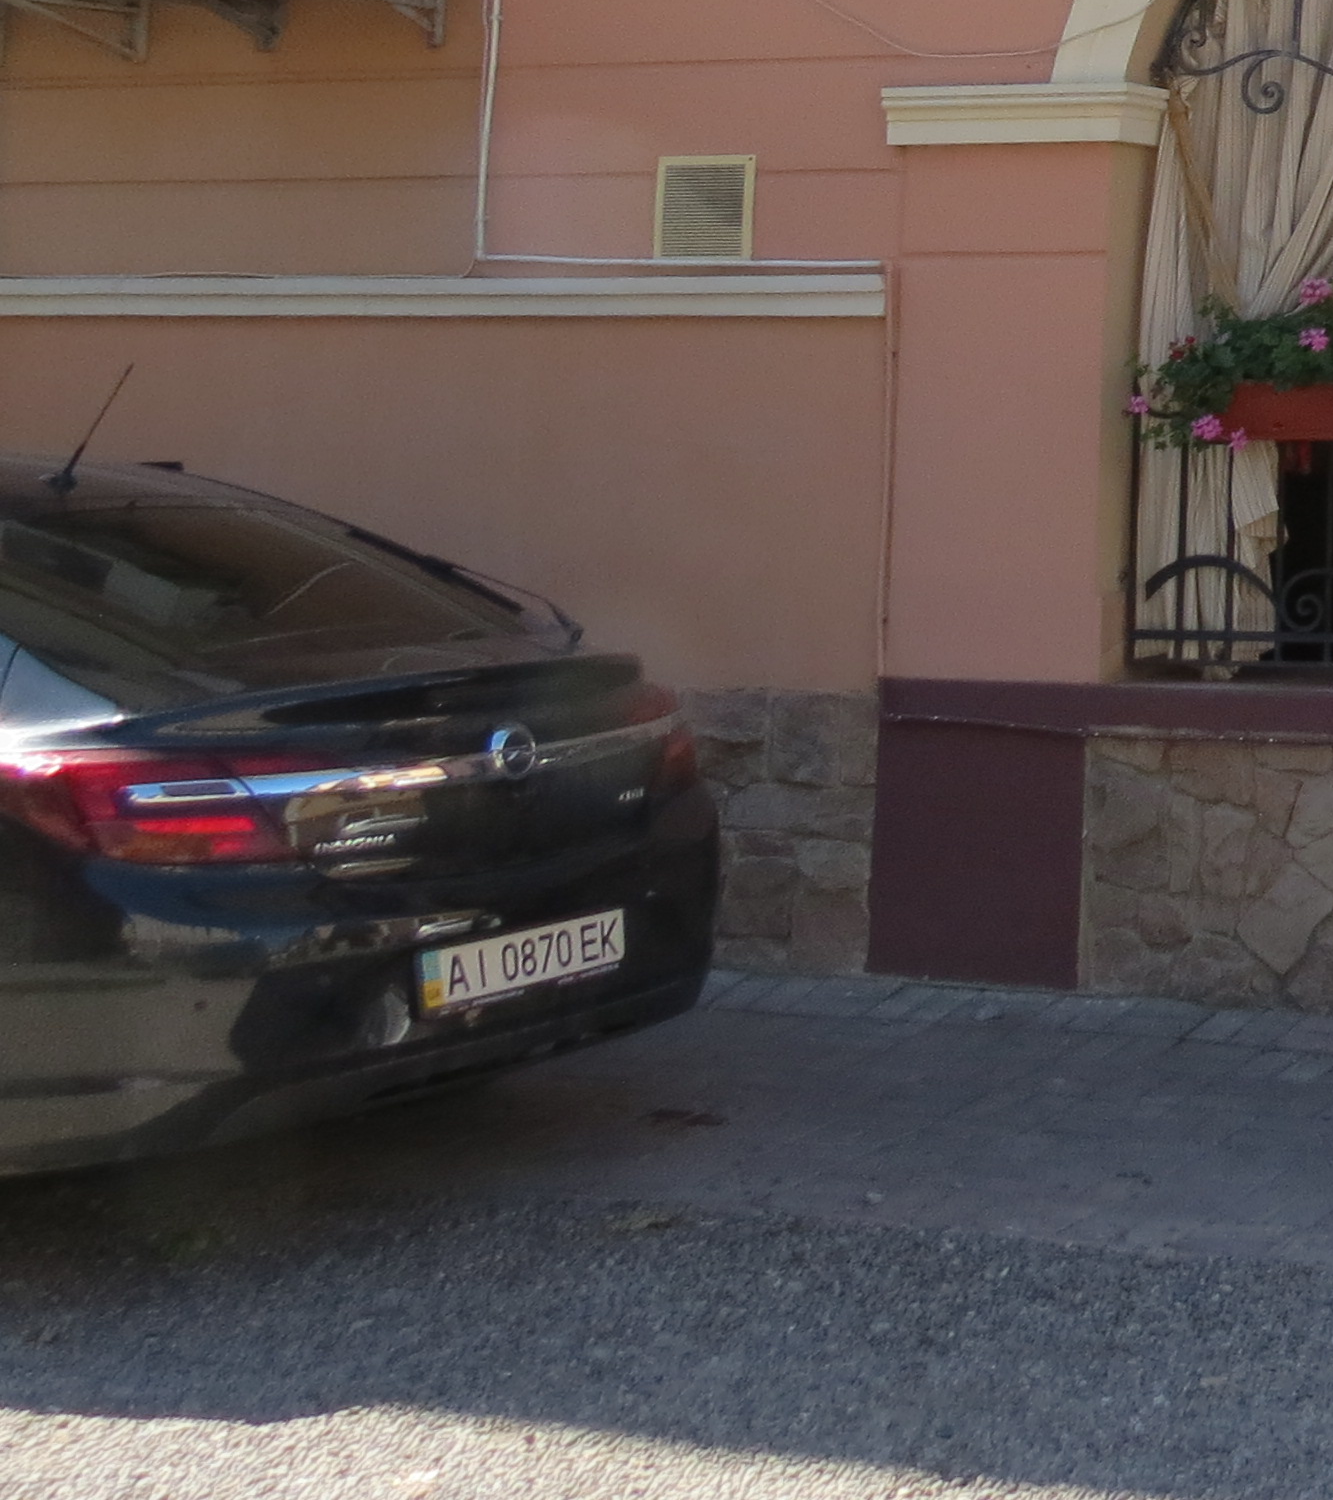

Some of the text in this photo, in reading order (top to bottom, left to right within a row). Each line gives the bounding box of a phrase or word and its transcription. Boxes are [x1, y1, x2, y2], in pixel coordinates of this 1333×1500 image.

[448, 949, 487, 996] AI
[501, 929, 572, 981] 0870
[580, 917, 619, 963] EK
